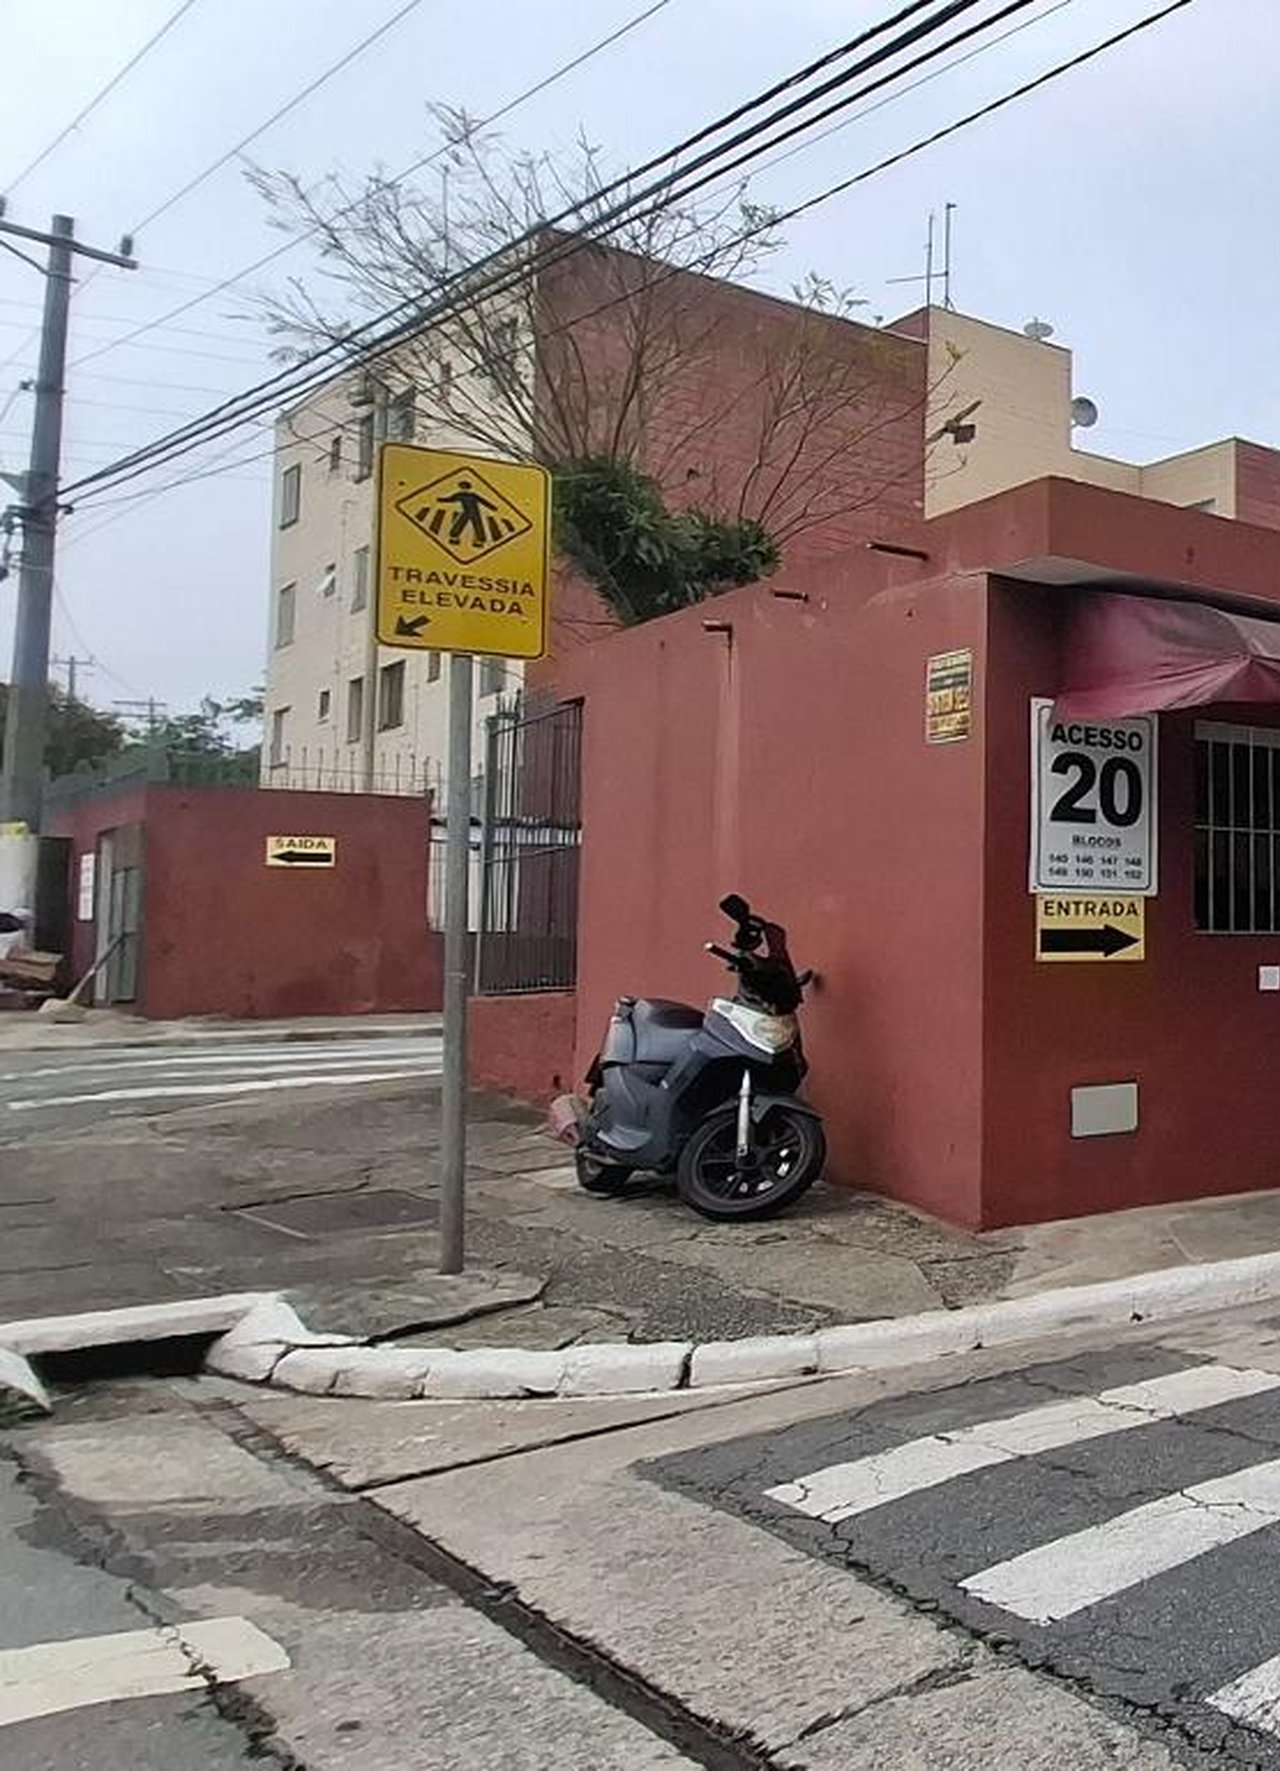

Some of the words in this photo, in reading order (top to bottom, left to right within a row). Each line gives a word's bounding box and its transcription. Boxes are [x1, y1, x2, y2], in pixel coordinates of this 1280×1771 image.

[387, 566, 536, 598] TRAVESSIA
[401, 589, 524, 616] ELEVADA
[1051, 723, 1143, 751] ACESSO
[1050, 751, 1143, 828] 20
[1072, 835, 1122, 848] BLOCOS
[1043, 900, 1139, 917] ENTRADA
